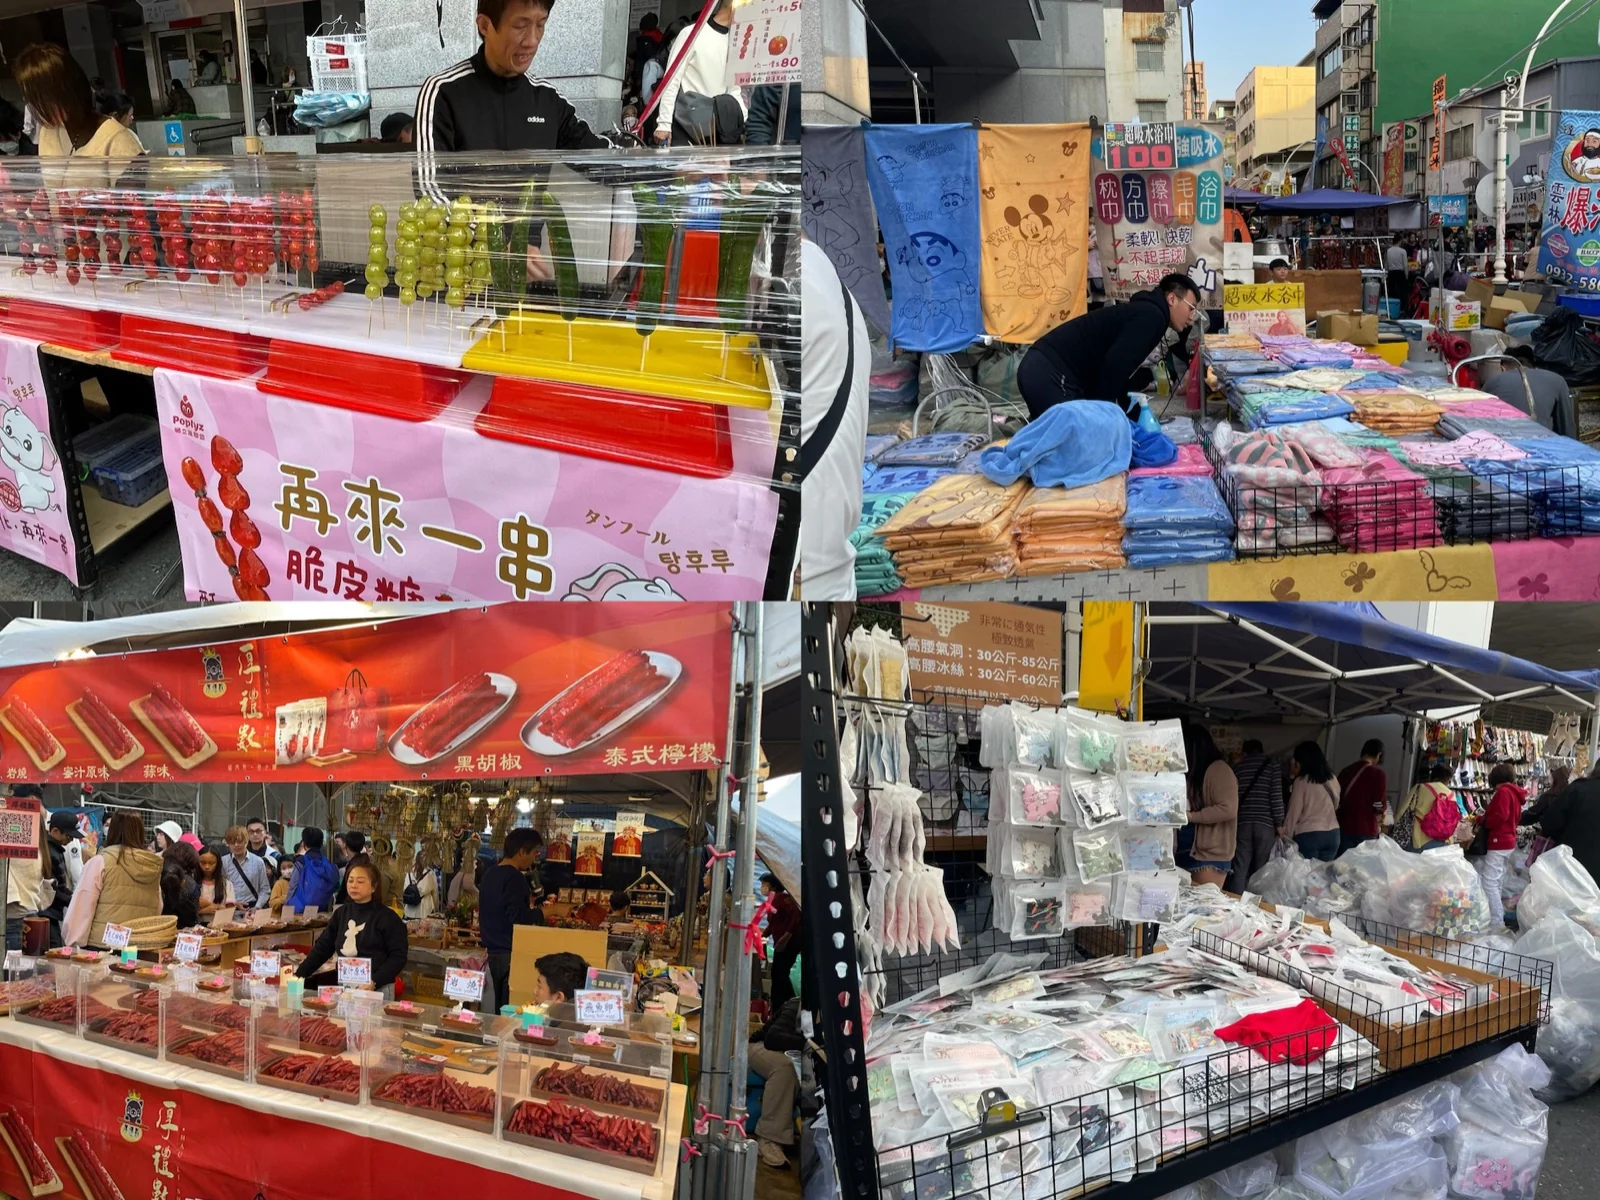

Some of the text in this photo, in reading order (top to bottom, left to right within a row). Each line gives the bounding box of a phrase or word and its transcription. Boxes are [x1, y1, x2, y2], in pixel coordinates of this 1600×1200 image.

[1124, 123, 1173, 145] 超吸水浴巾
[1110, 145, 1172, 169] 100
[1099, 178, 1119, 219] 枕巾
[1124, 179, 1145, 219] 方巾
[1151, 179, 1169, 219] 擦巾
[1176, 177, 1194, 219] 毛巾
[1200, 176, 1218, 219] 浴巾
[1548, 182, 1565, 225] 雲林
[985, 226, 1011, 245] NEVER
[992, 233, 1014, 248] LATE
[1225, 285, 1304, 308] 超吸水浴巾
[1227, 312, 1246, 321] 100
[274, 463, 552, 599] 再來一串
[585, 509, 670, 545] タンフール
[659, 550, 734, 574] 탕후루
[991, 632, 1035, 650] 極致透氣
[454, 753, 522, 773] 黑胡椒
[602, 742, 716, 767] 泰式檸檬
[6, 767, 28, 779] 岩燒
[63, 765, 110, 779] 蜜汁原味
[143, 764, 171, 778] 蒜味
